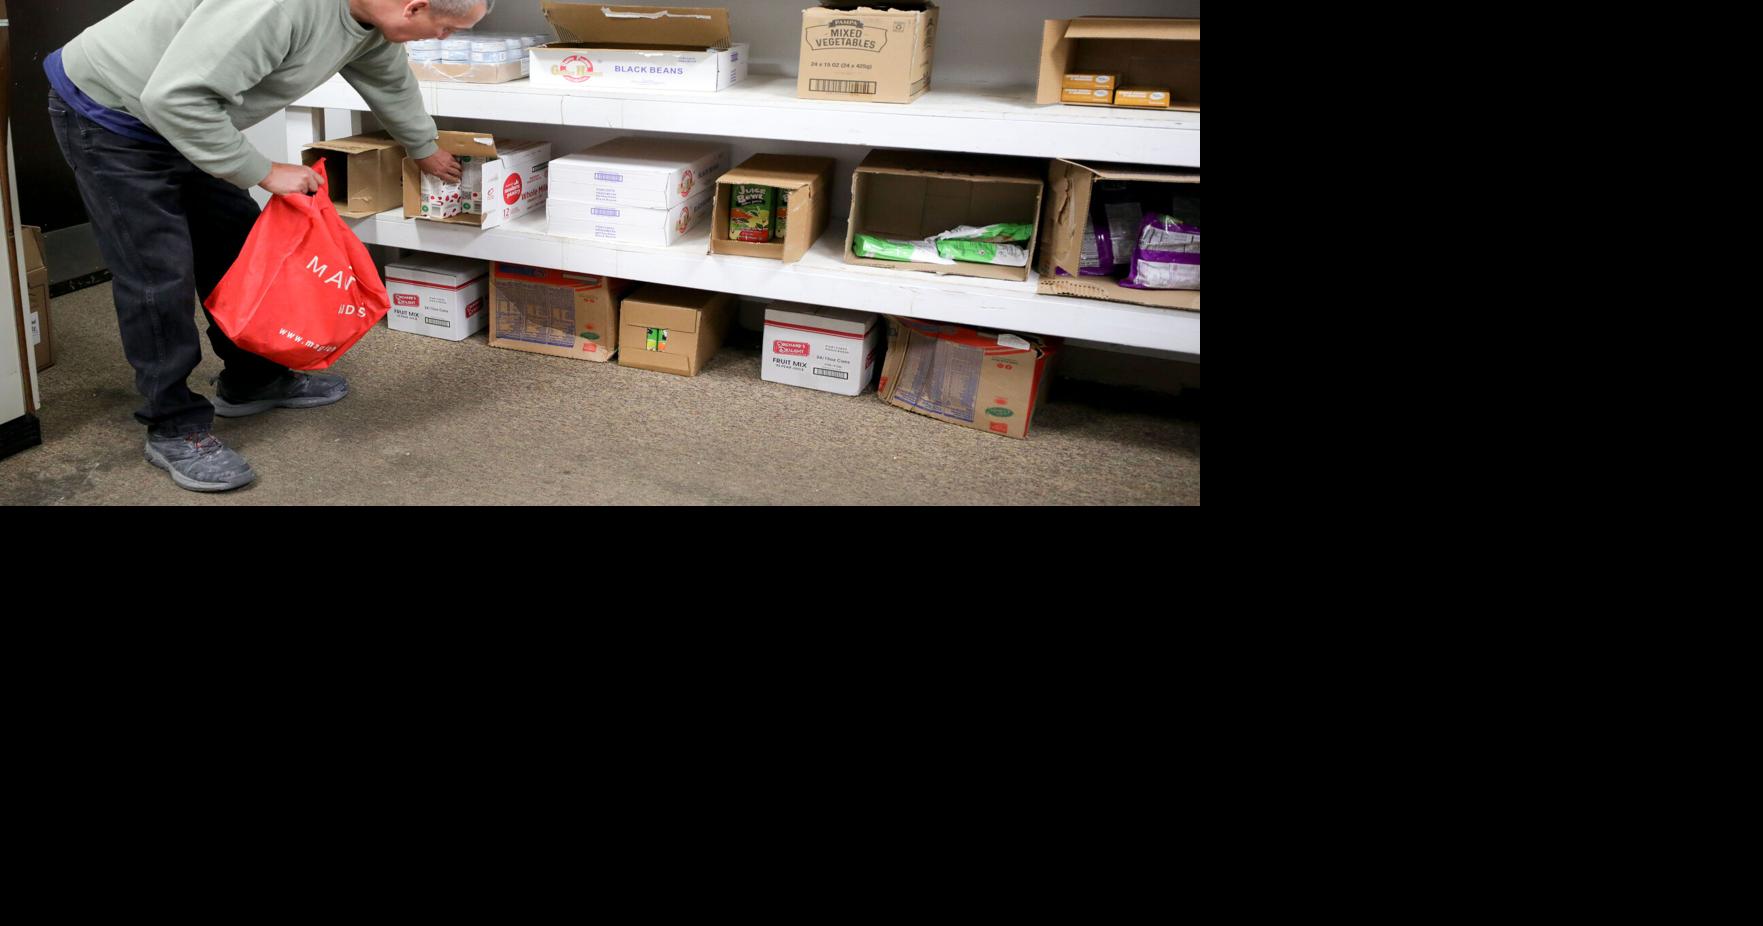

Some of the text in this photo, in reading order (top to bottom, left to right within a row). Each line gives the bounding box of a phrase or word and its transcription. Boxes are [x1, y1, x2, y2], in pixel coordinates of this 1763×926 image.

[830, 29, 863, 39] MIXED
[815, 38, 876, 49] VEGETABLES
[614, 65, 685, 75] BLACK BEANS
[503, 207, 511, 217] 12
[772, 357, 791, 366] FRUIT
[792, 361, 808, 369] MIX
